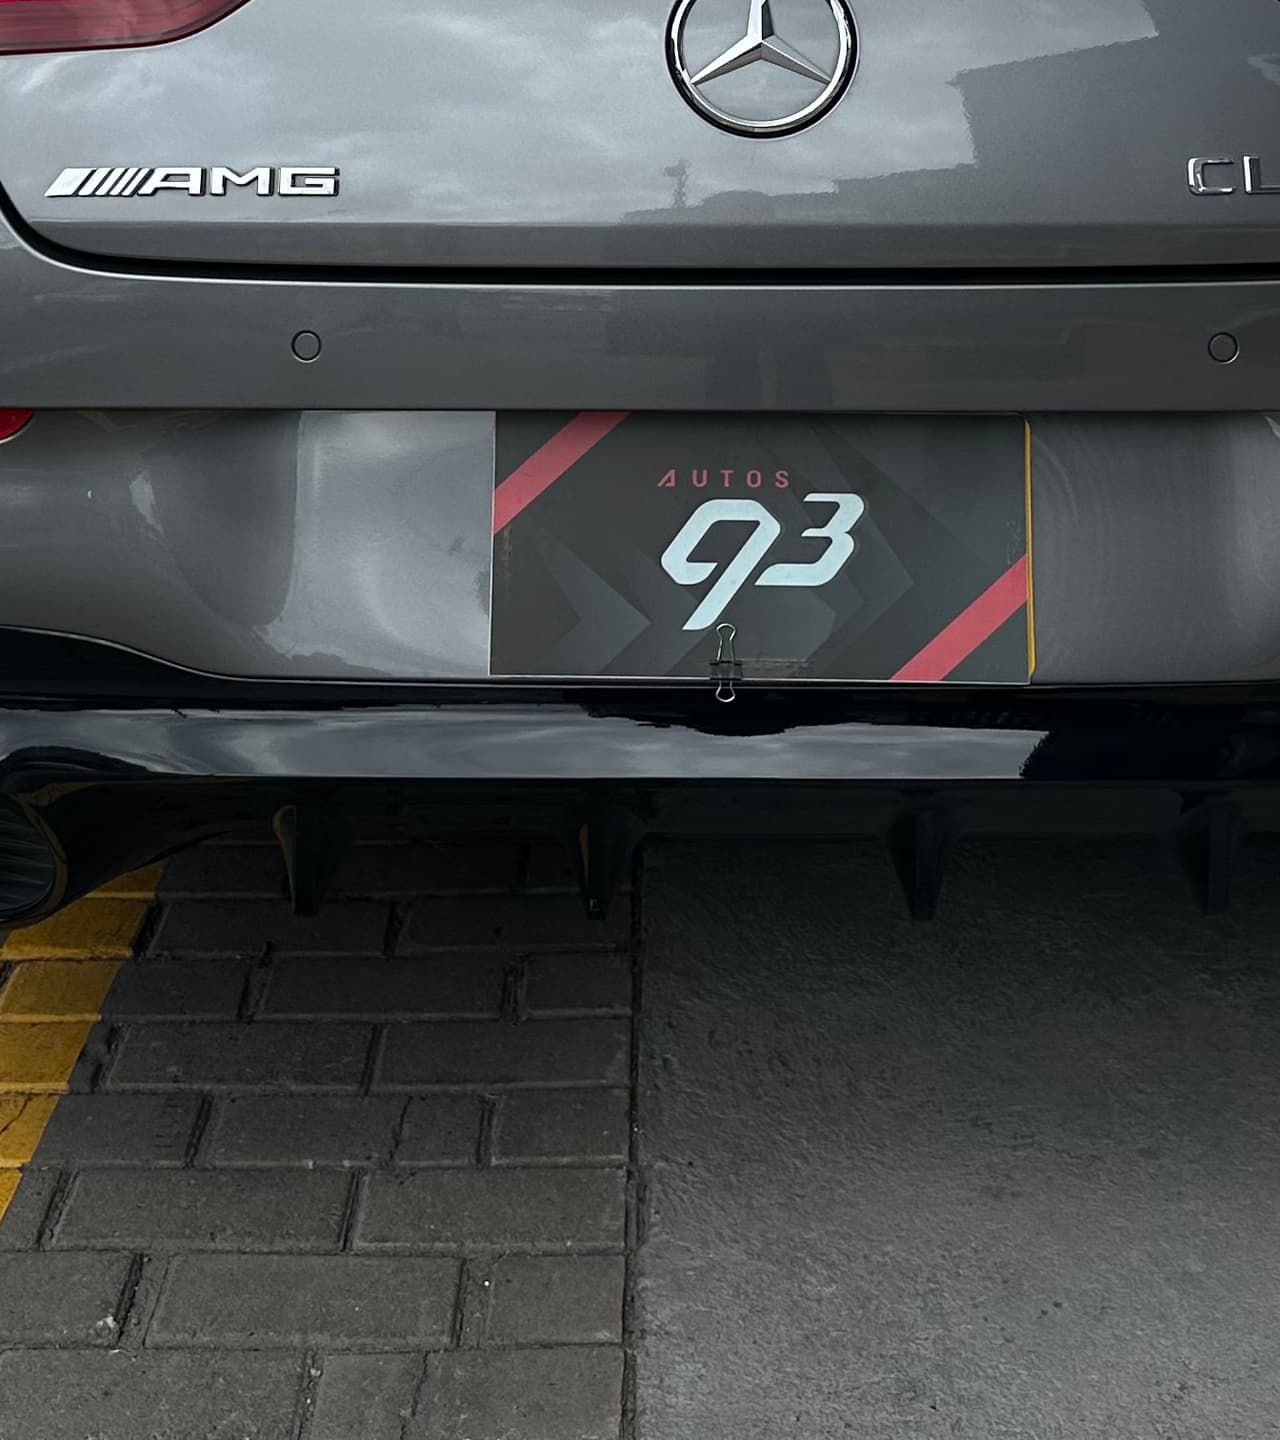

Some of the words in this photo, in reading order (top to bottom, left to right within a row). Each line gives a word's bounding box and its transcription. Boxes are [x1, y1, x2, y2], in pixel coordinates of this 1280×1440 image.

[137, 166, 340, 197] AMG
[656, 468, 791, 489] AUTOS
[660, 492, 866, 632] 93
